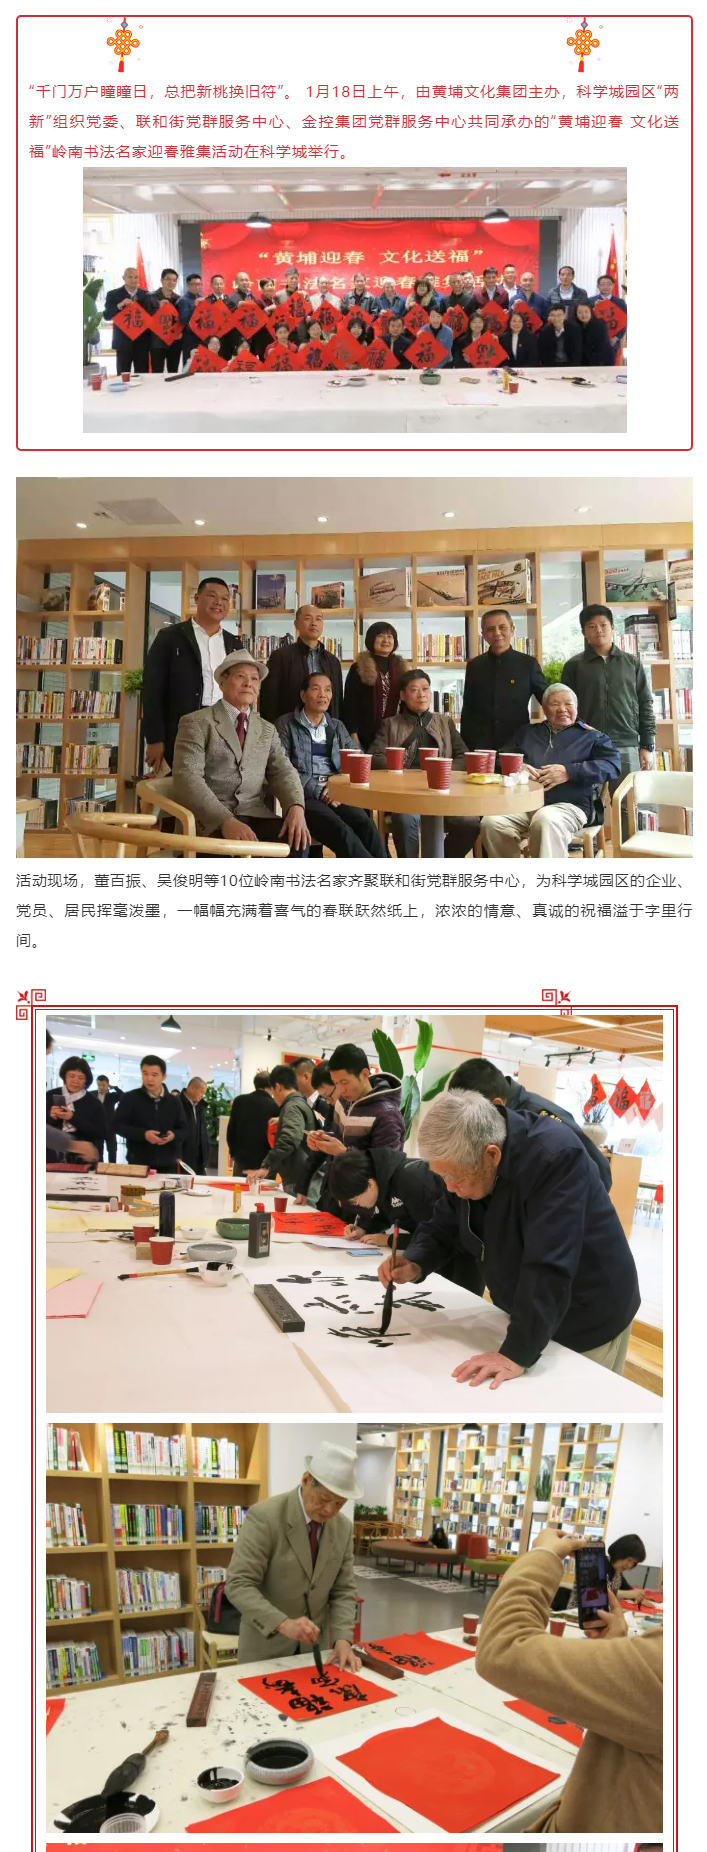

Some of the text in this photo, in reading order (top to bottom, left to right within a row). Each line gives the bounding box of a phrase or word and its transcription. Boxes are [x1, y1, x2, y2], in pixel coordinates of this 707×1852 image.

[123, 305, 144, 329] 福
[239, 308, 259, 329] 福
[288, 298, 306, 319] 福
[306, 347, 324, 369] 福
[416, 341, 437, 363] 福
[613, 1086, 630, 1111] 福
